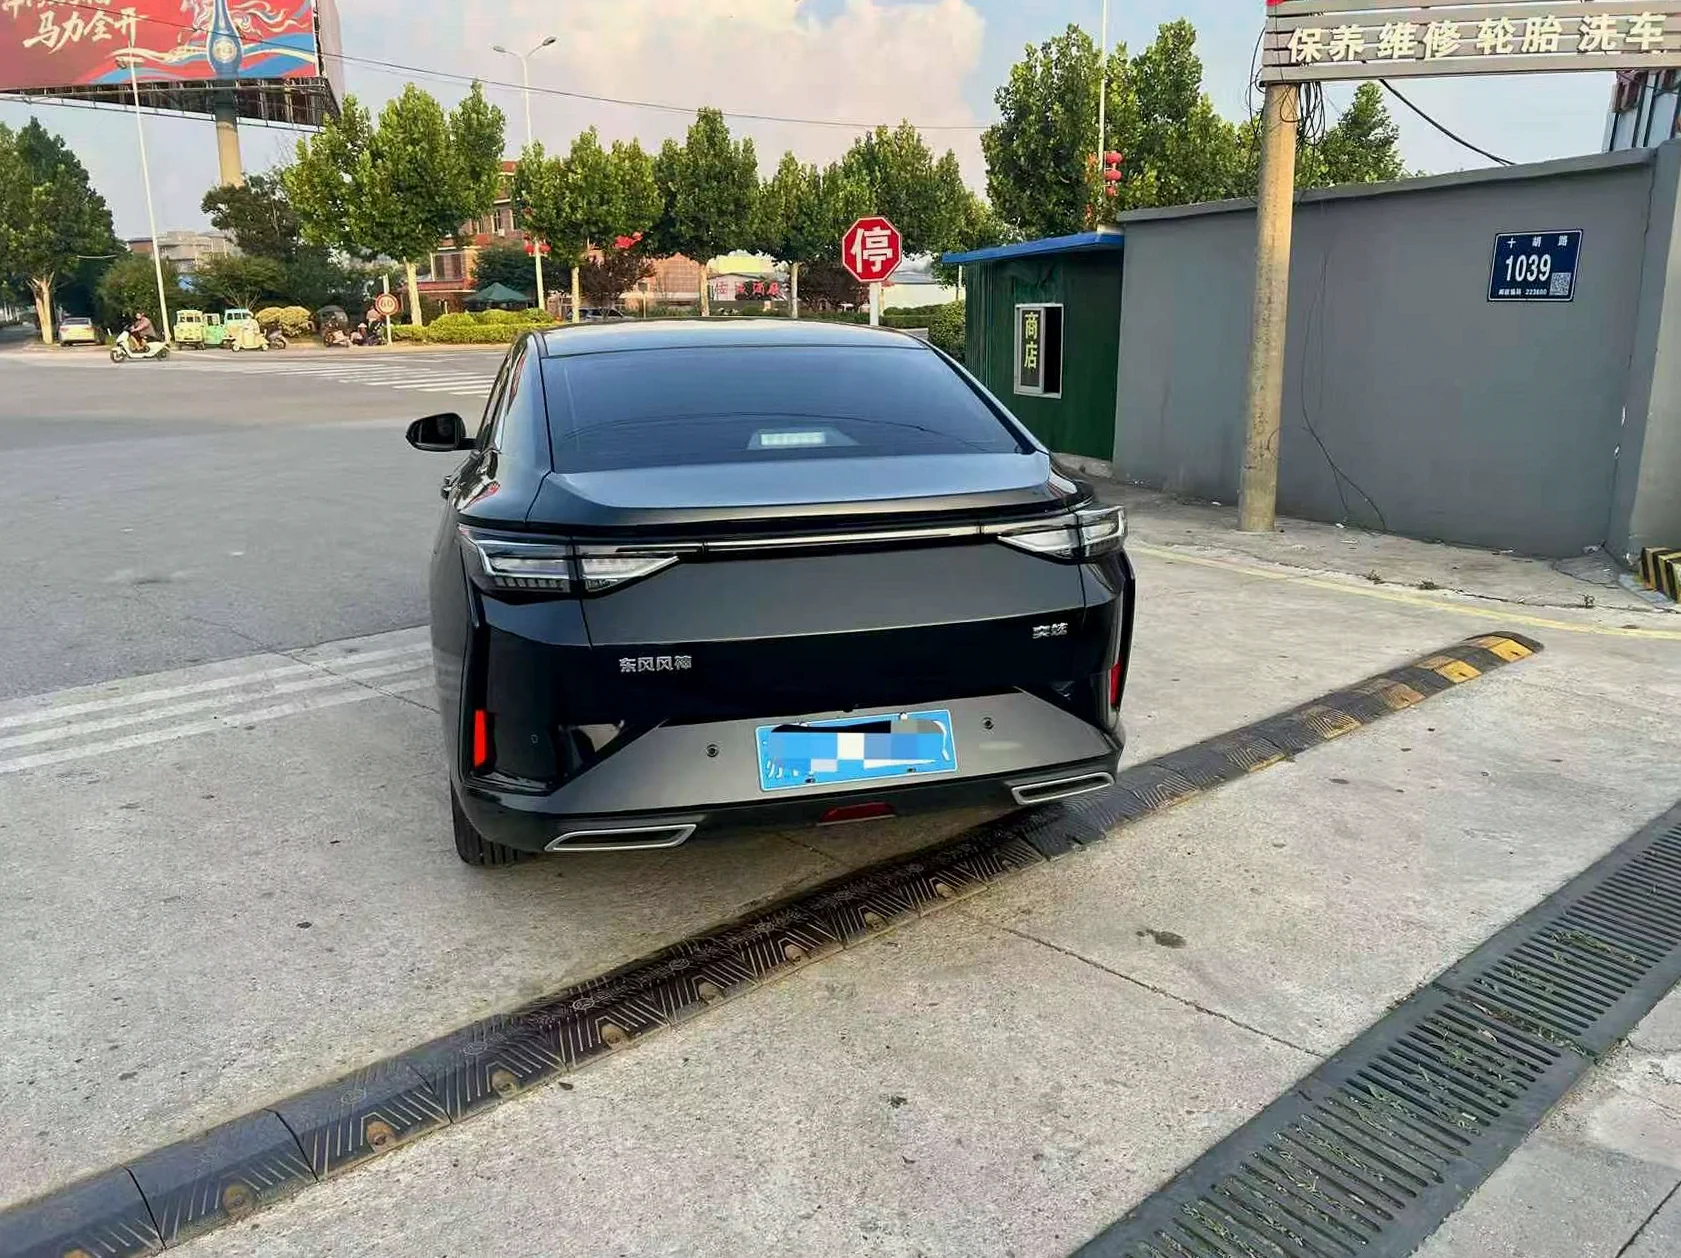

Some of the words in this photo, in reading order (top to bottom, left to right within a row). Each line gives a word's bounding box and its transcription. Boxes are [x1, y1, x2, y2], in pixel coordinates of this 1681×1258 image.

[22, 7, 149, 54] 马力全开
[851, 226, 893, 273] 停
[1505, 254, 1551, 282] 1039
[1024, 311, 1039, 369] 商店
